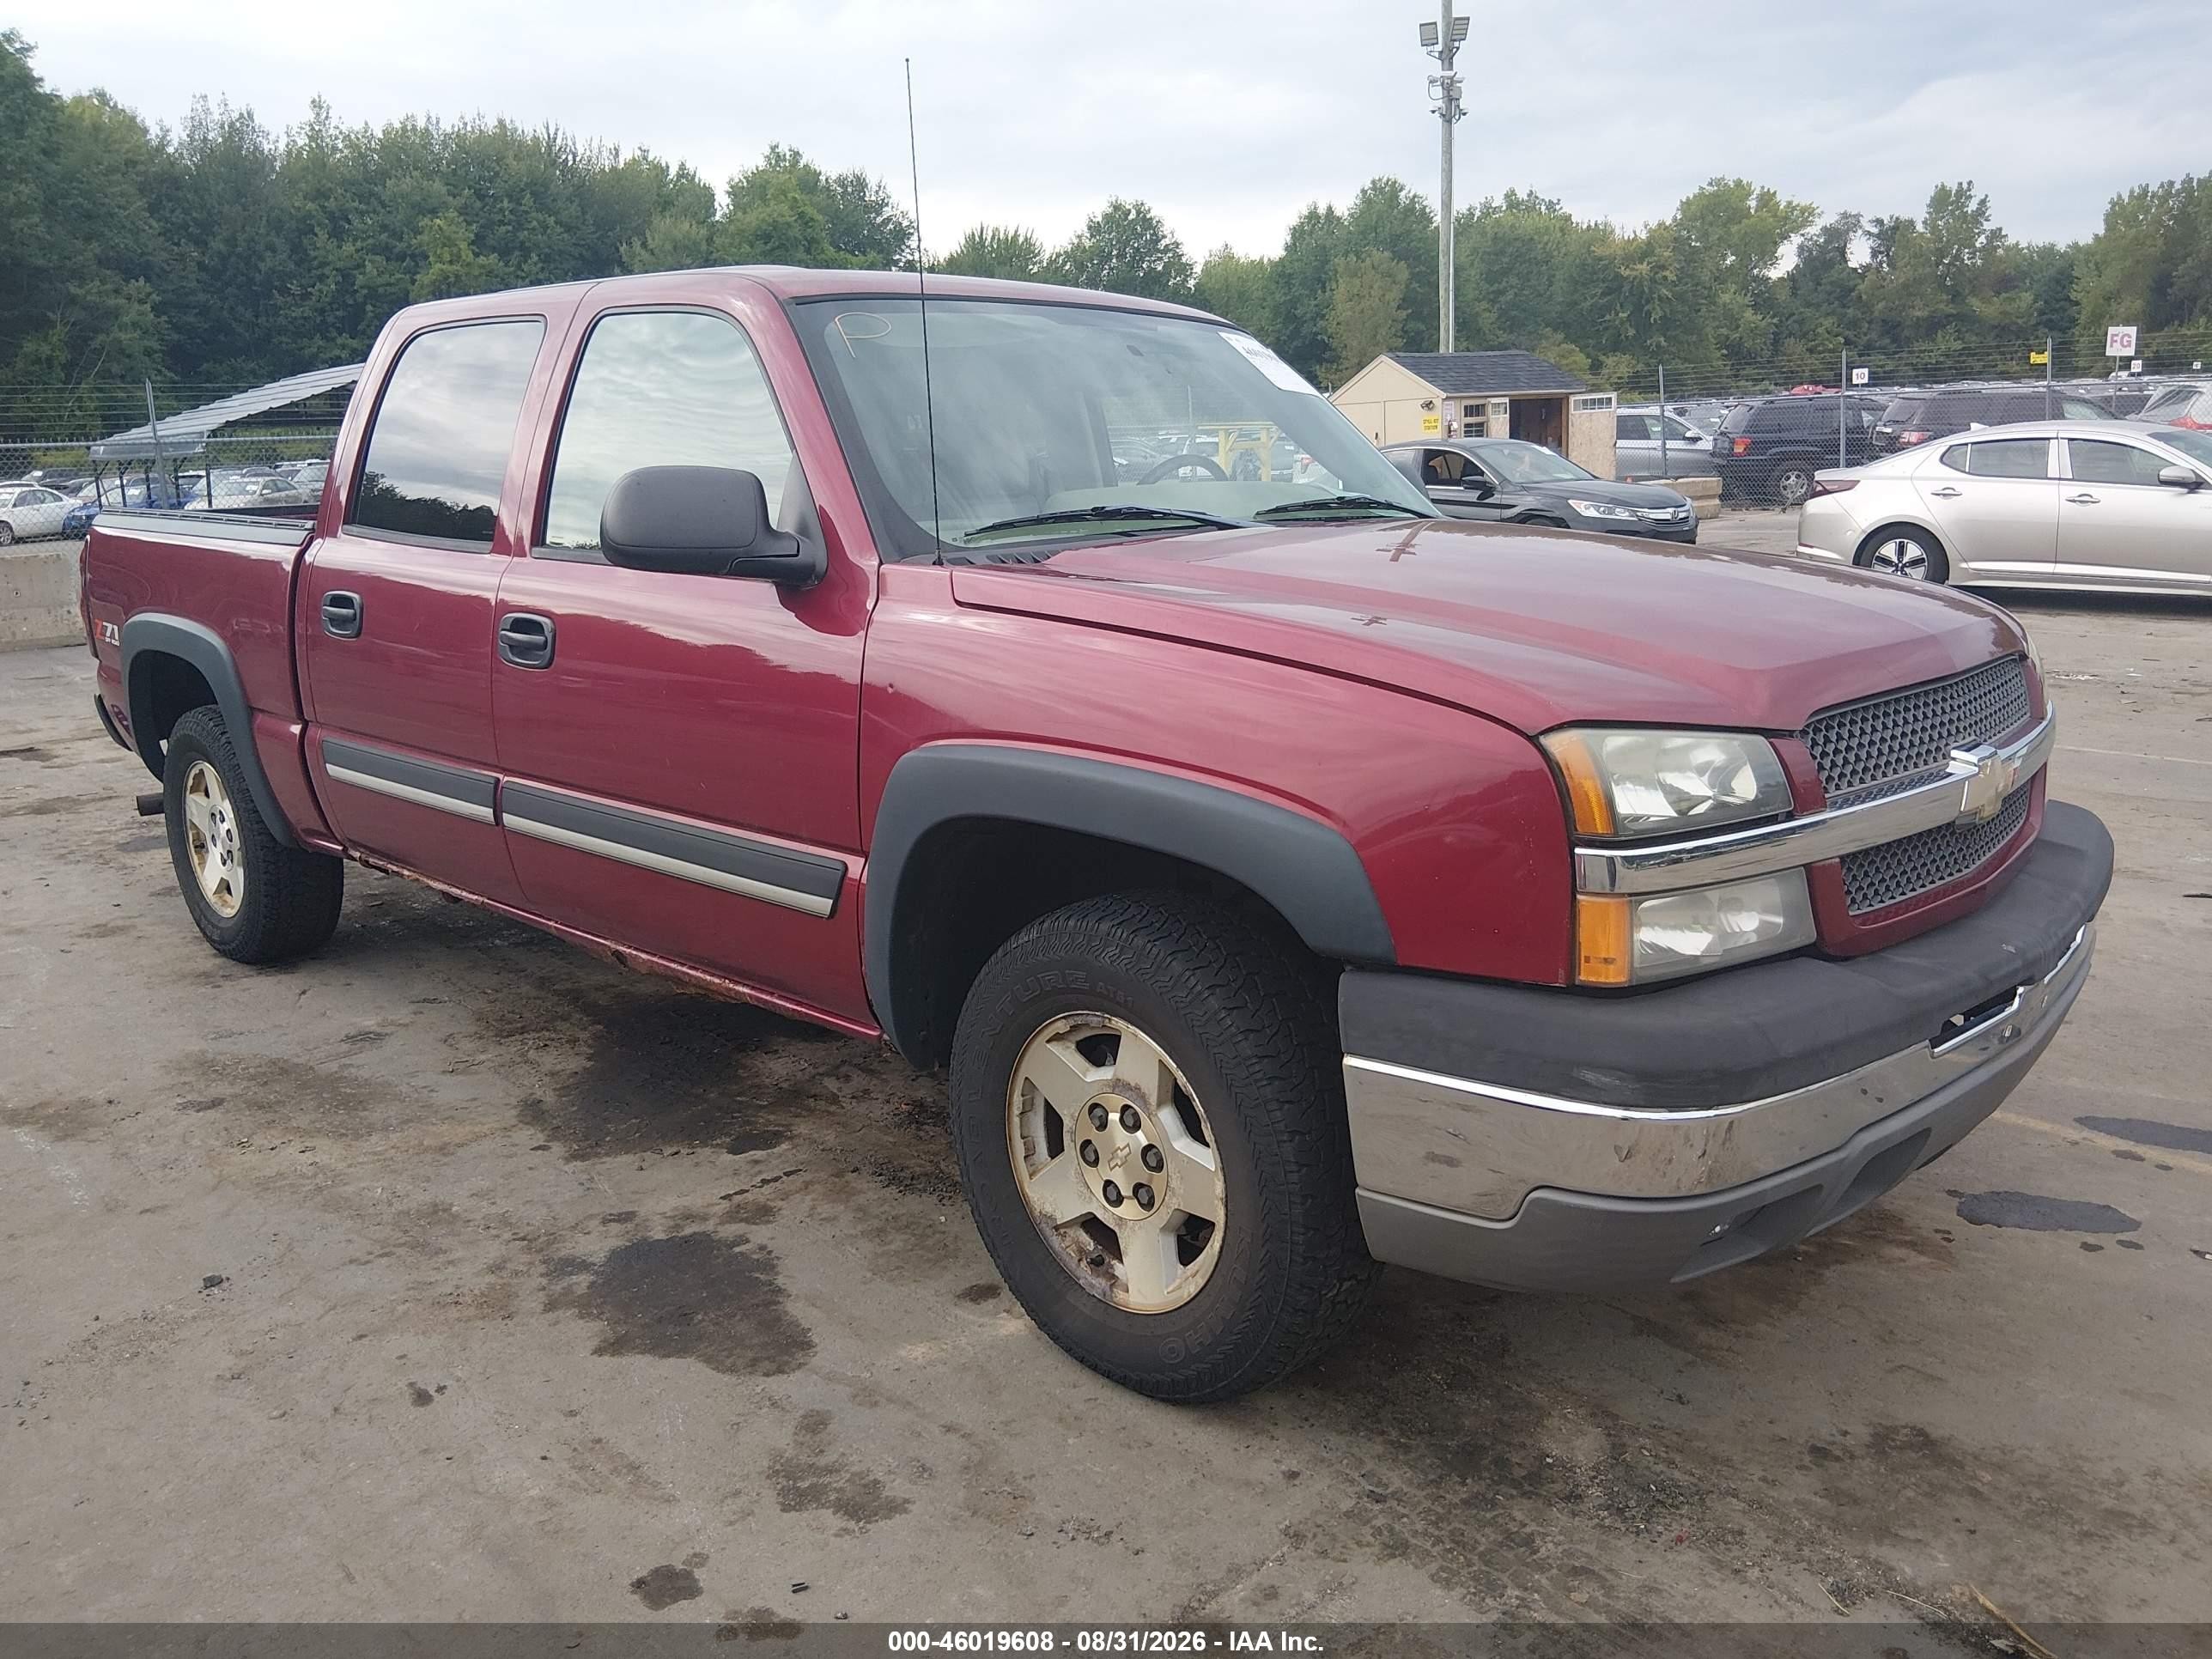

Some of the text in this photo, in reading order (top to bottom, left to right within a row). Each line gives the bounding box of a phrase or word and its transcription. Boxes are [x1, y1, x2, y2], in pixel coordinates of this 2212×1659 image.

[2110, 333, 2132, 349] FG
[1856, 372, 1866, 380] 10
[94, 618, 119, 641] Z71
